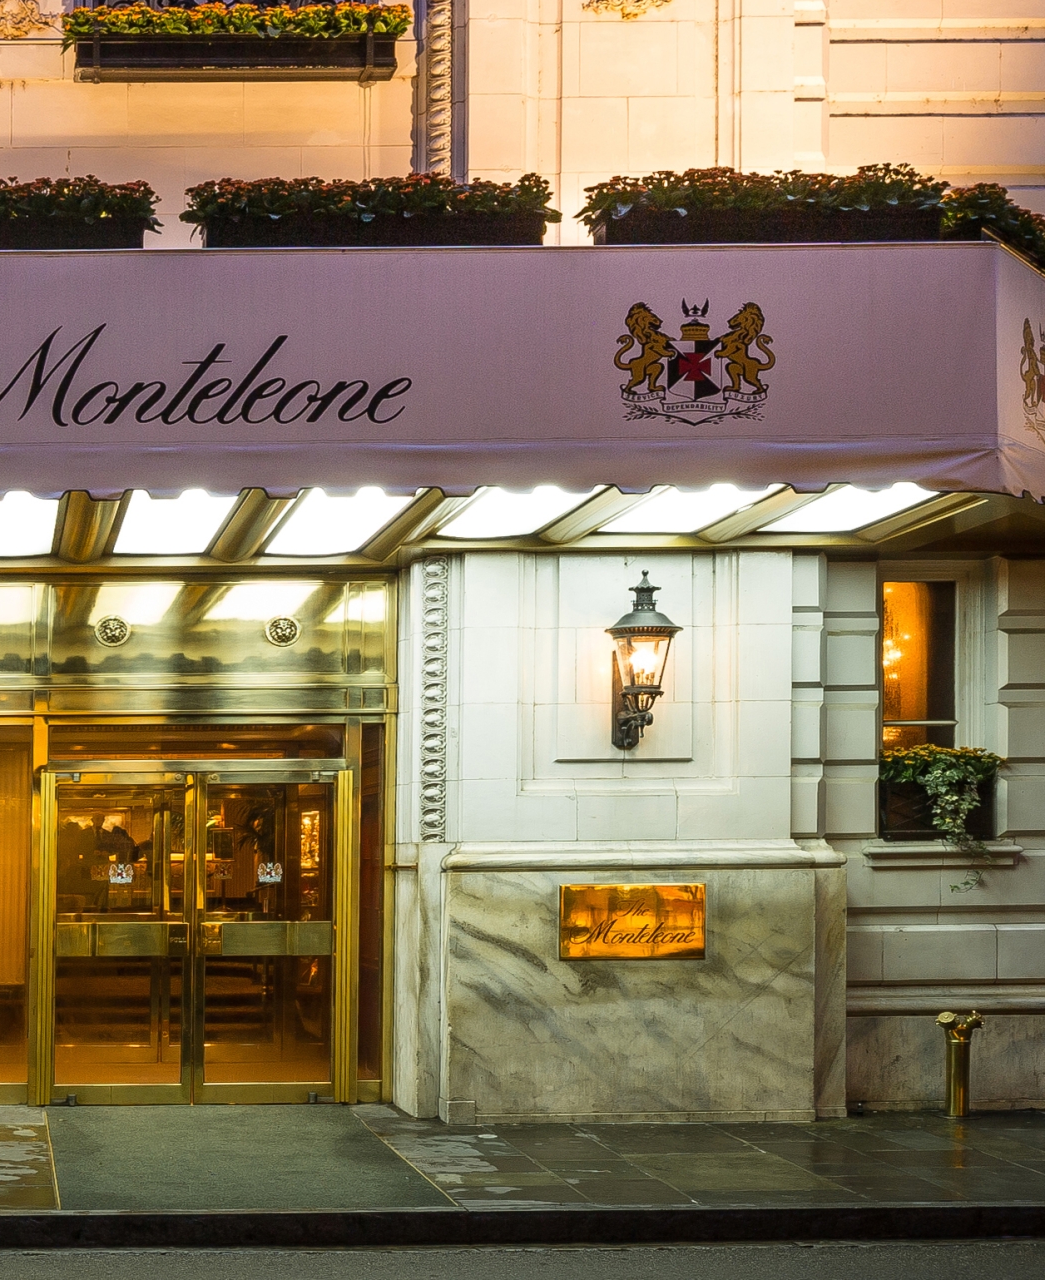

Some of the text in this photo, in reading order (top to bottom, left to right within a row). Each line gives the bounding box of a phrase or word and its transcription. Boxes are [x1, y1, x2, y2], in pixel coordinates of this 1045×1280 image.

[665, 403, 724, 411] DEPENDABILITY
[615, 897, 650, 917] The
[569, 919, 696, 945] Monteleone
